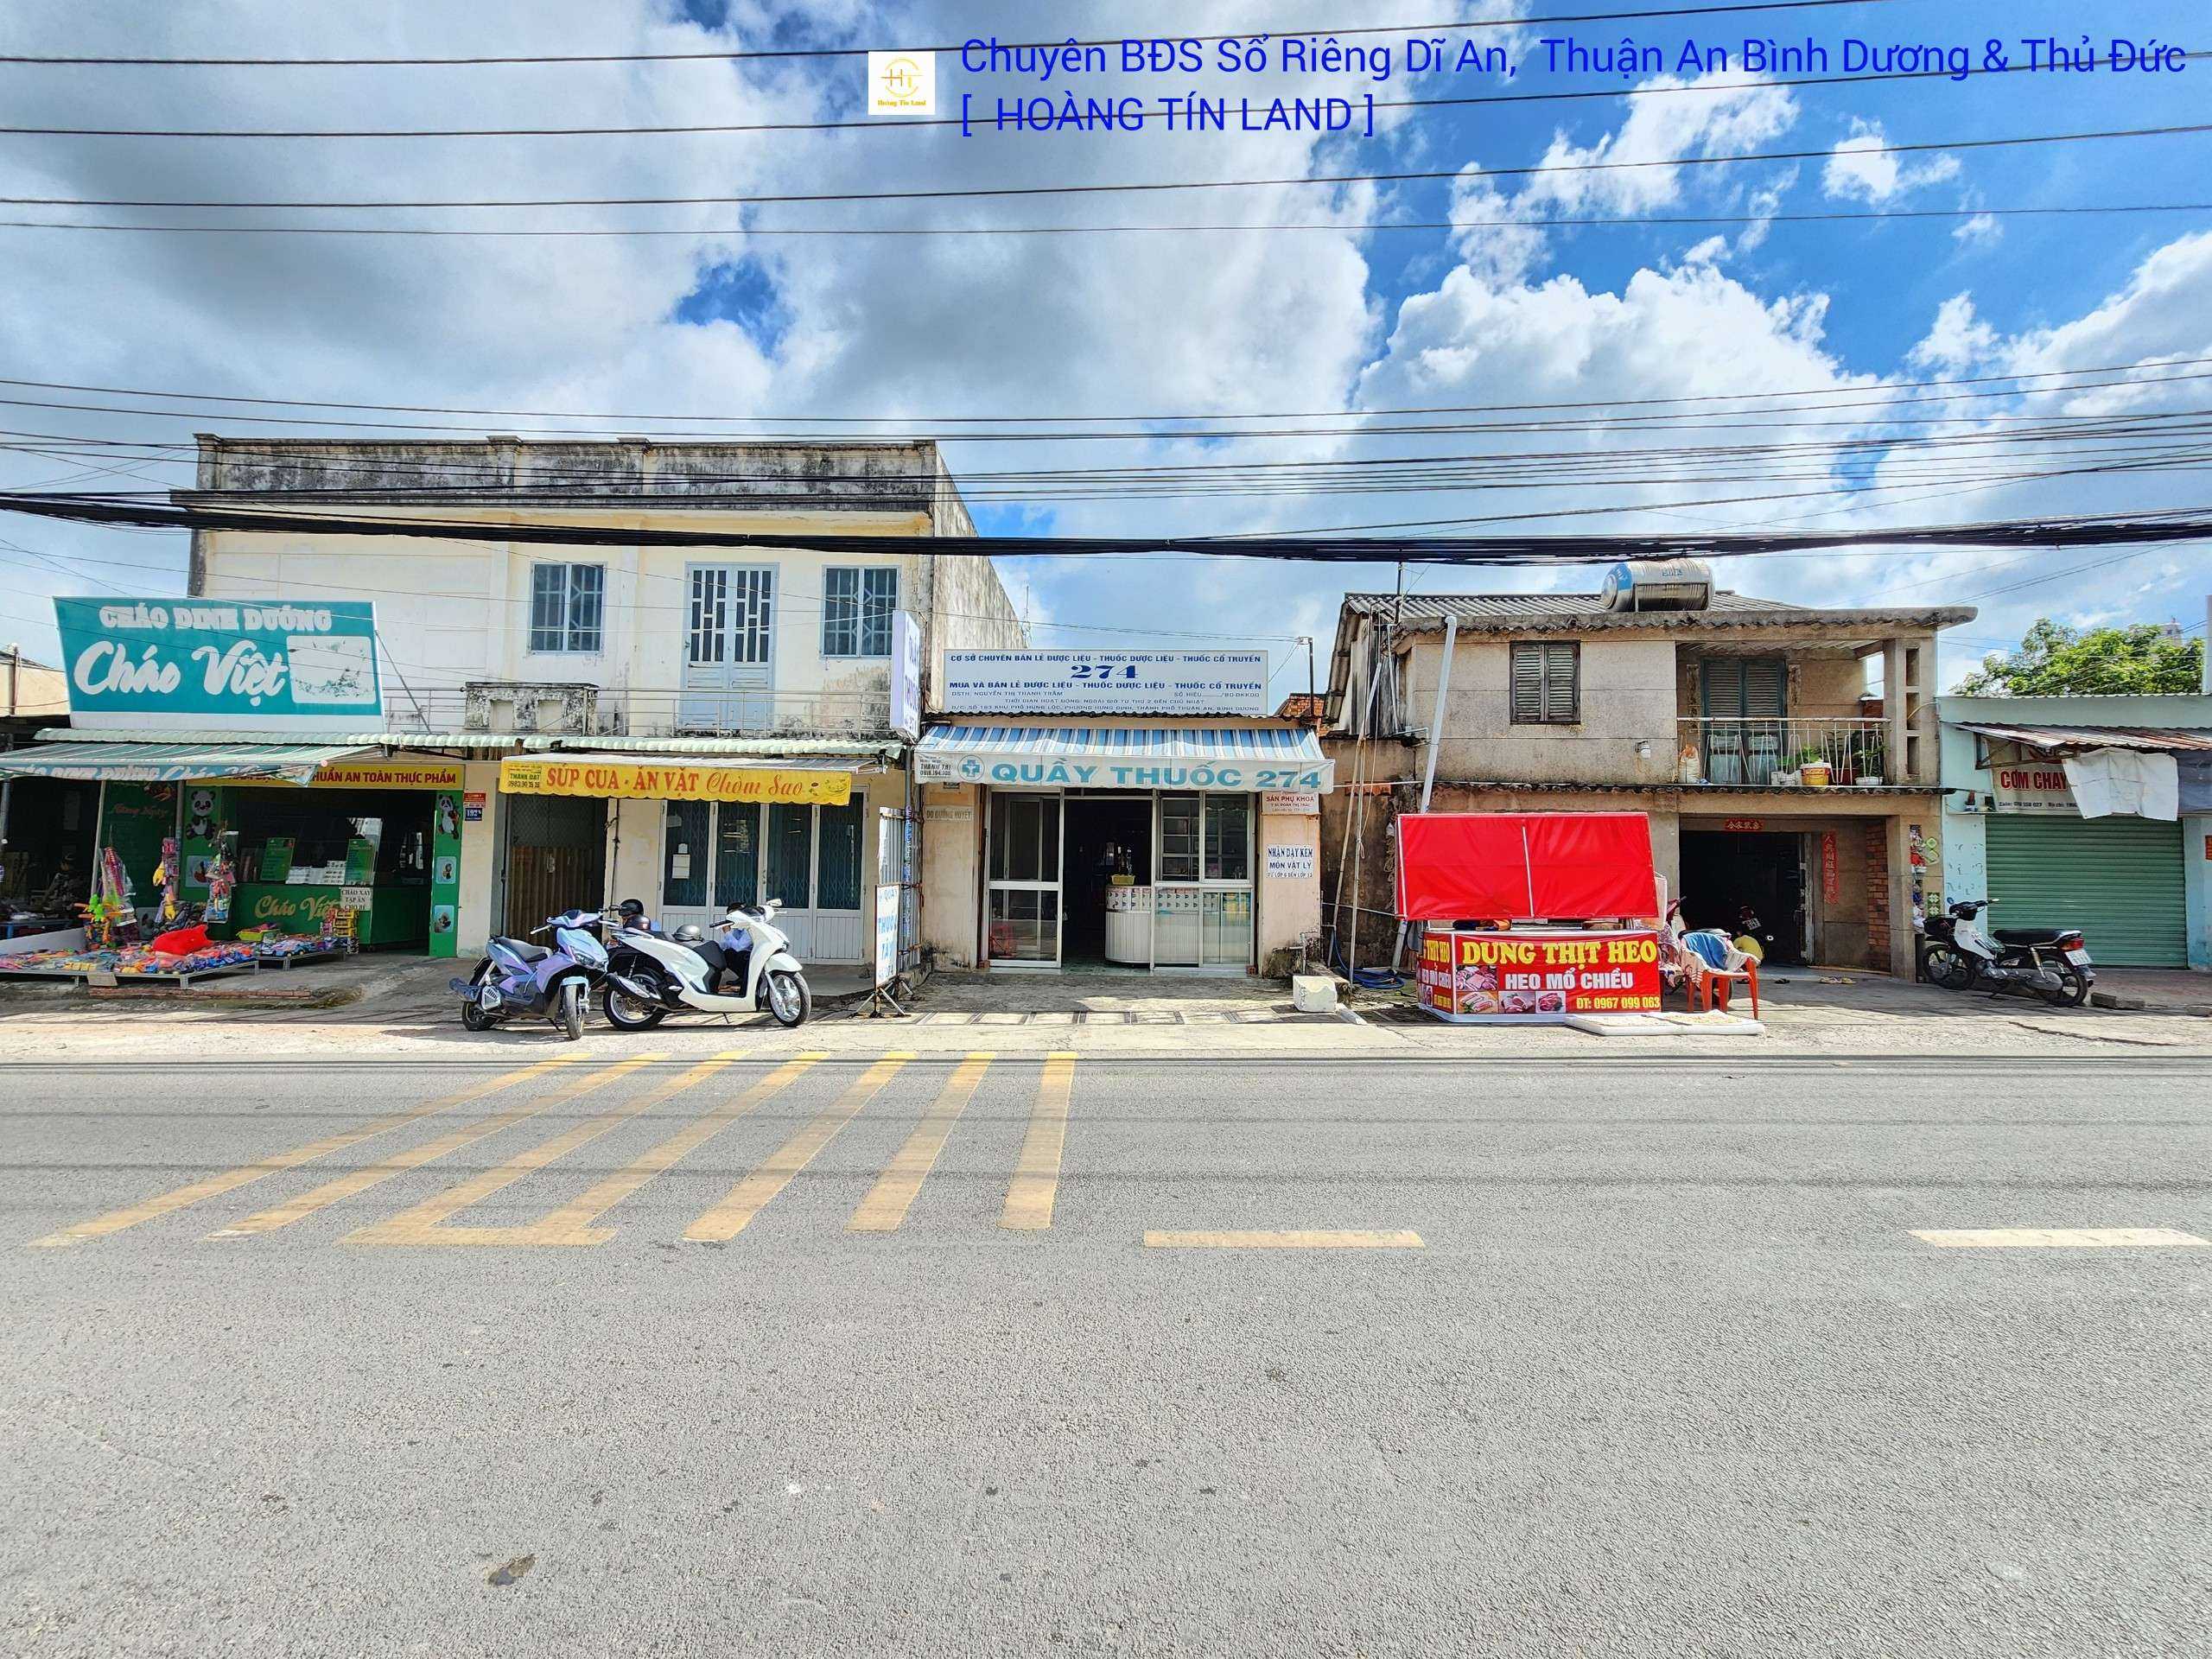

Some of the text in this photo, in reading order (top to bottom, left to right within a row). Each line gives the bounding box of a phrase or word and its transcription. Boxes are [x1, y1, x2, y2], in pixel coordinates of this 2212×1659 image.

[99, 603, 168, 629] CHÁO
[175, 607, 238, 631] DINH
[1072, 654, 1091, 663] LIỆU
[1100, 653, 1127, 662] THUỐC
[1183, 653, 1210, 662] THUỐC
[73, 639, 288, 706] Cháo Việt
[1071, 664, 1139, 679] 274
[988, 680, 1007, 689] BÁN
[1052, 681, 1072, 690] LIỆU
[1082, 680, 1112, 689] THUỐC
[1144, 681, 1165, 690] LIỆU
[1175, 681, 1205, 690] THUỐC
[313, 766, 456, 785] HUẨN AN TOÀN THỰC PHẨM
[546, 763, 803, 797] SÚP CUA ĂN VẶT Chòm Sao
[992, 758, 1321, 789] QUẦY THUỐC 274
[2000, 770, 2067, 790] CƠM CHAY
[1269, 861, 1286, 869] MÔN
[1287, 861, 1300, 870] VẬT
[255, 895, 296, 918] Cháo
[1462, 939, 1657, 970] DUNG THỊT HEO
[1504, 967, 1634, 989] HEO MỔ CHIỀU
[1593, 997, 1618, 1009] 0967
[1621, 997, 1640, 1009] 099
[1643, 996, 1660, 1008] 063
